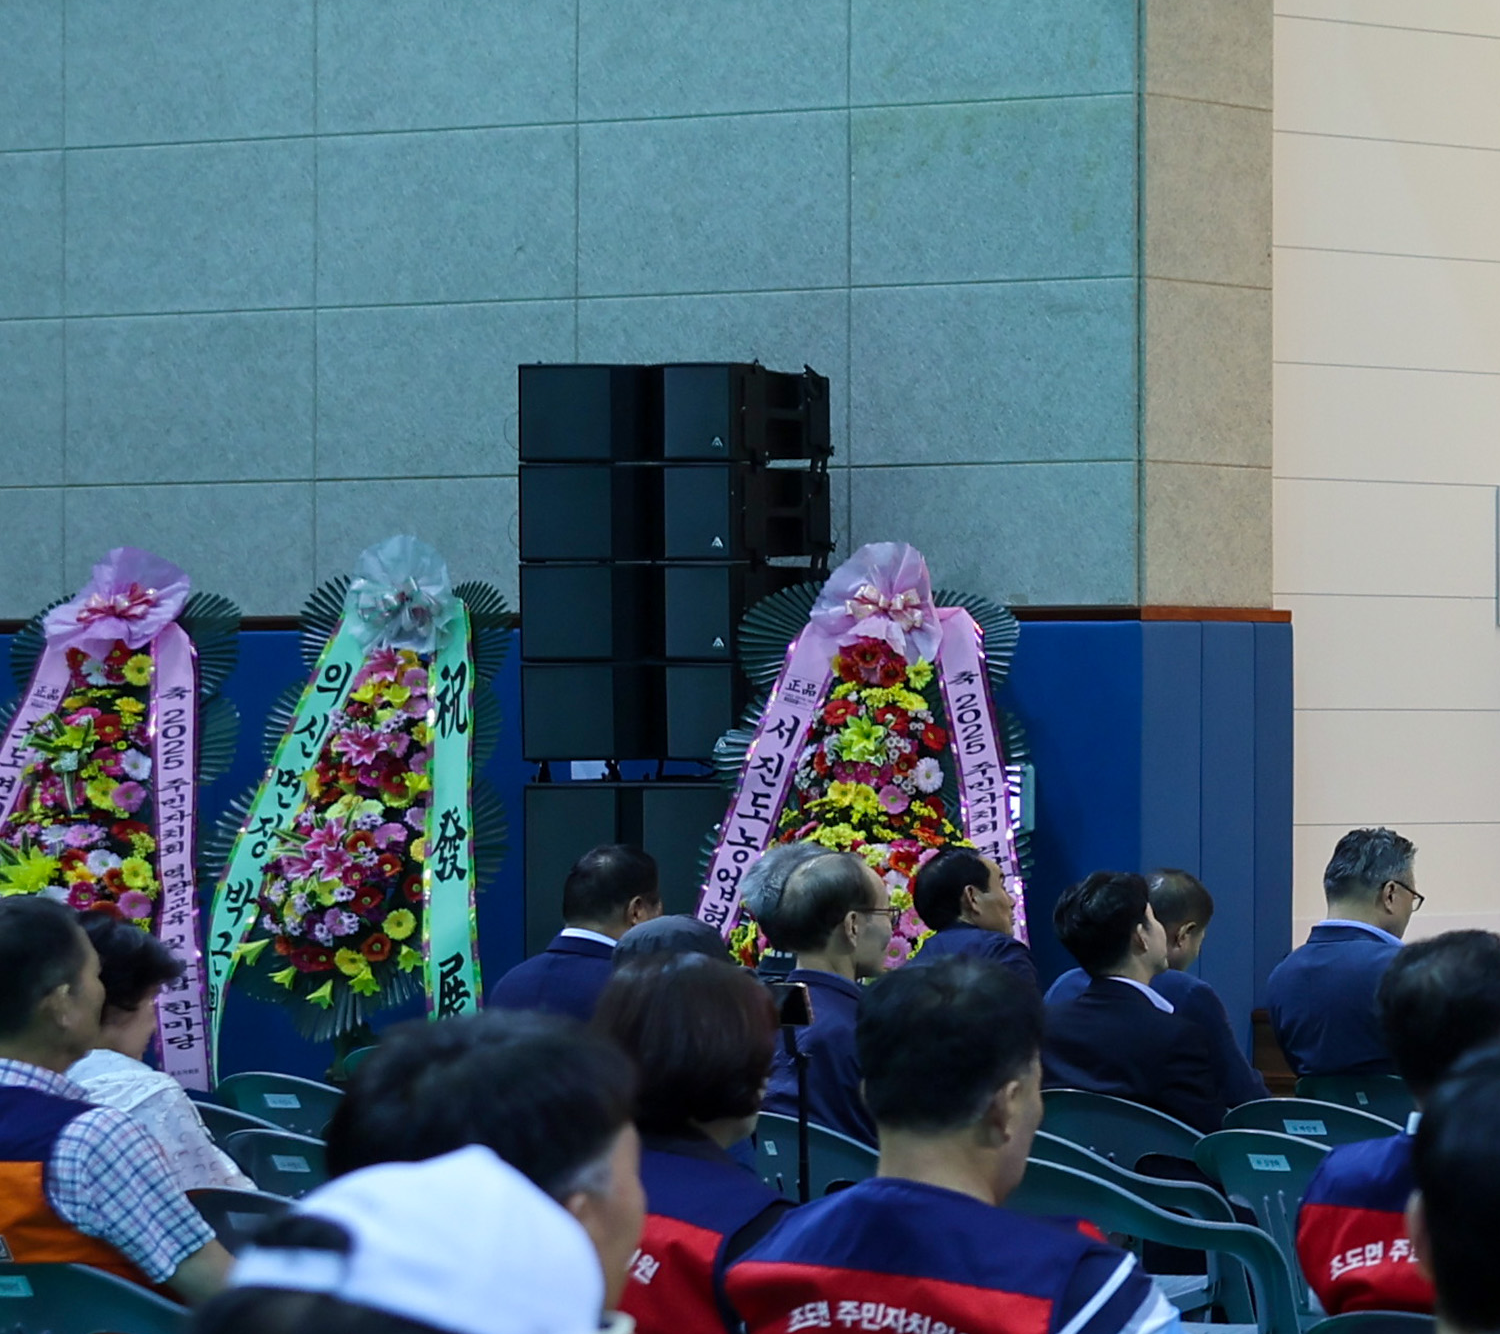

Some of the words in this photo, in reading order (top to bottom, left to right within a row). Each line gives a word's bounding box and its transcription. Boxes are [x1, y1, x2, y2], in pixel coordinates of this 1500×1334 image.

[161, 709, 187, 770] 2025
[954, 692, 987, 756] 2025
[160, 999, 203, 1050] 한마당
